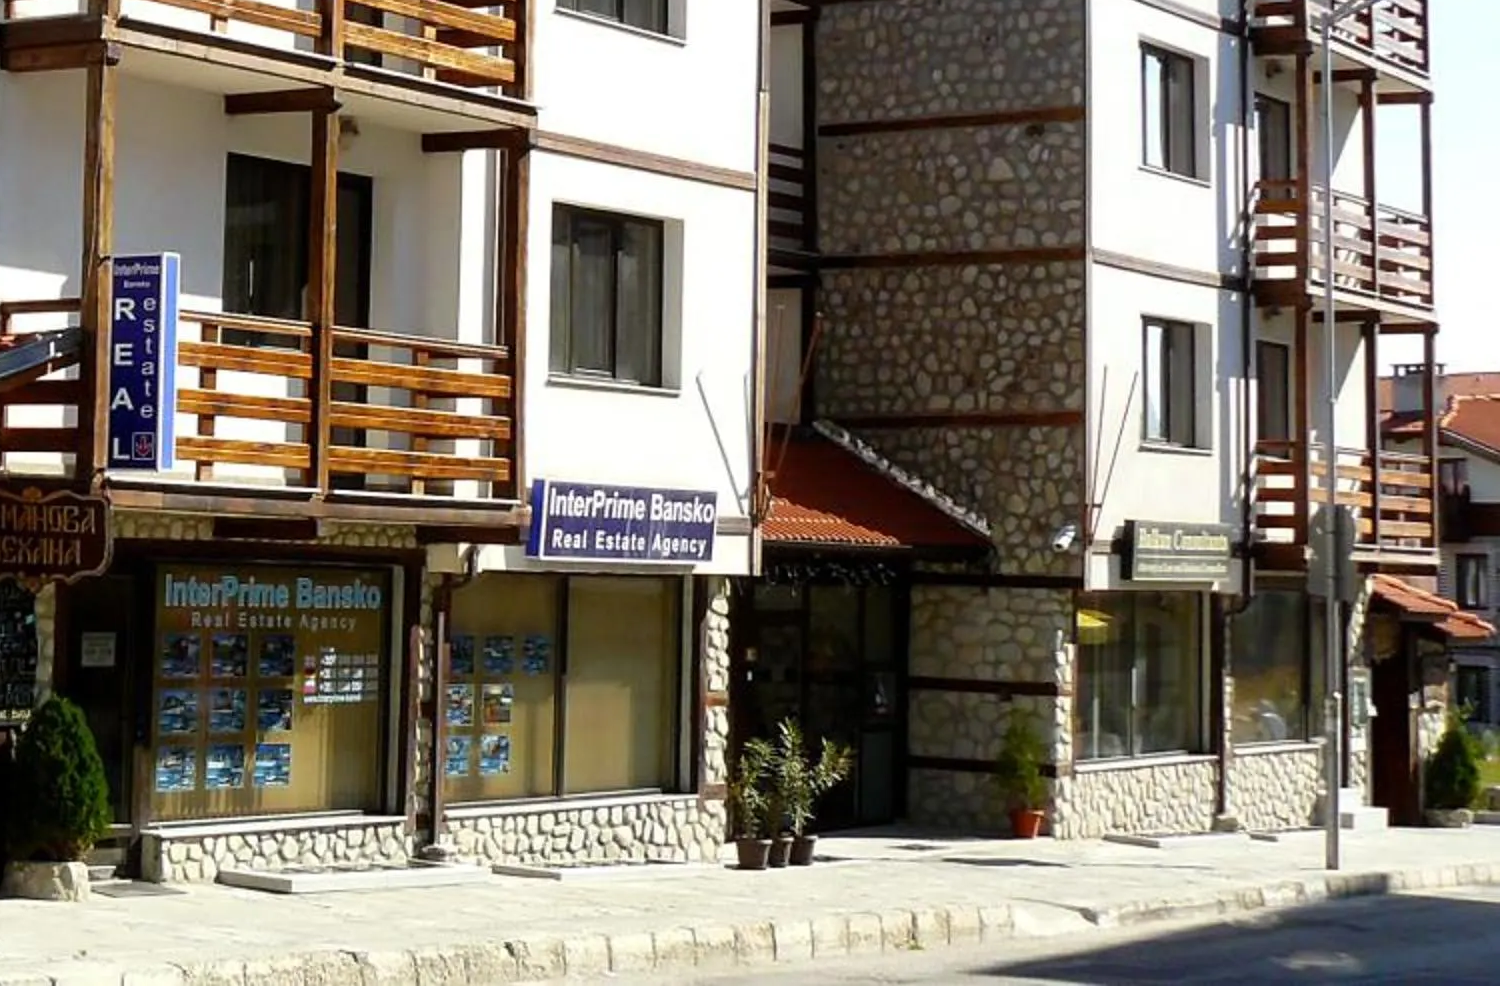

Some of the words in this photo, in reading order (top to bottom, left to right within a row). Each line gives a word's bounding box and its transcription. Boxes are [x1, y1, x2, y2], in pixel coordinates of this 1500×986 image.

[550, 487, 645, 520] InterPrime
[650, 493, 714, 523] Bansko
[552, 529, 587, 548] Real
[595, 530, 645, 551] Estate
[652, 533, 707, 557] Agency
[165, 574, 288, 608] InterPrime
[296, 577, 381, 609] Bansko
[191, 611, 229, 628] Real
[238, 612, 292, 628] Estate
[300, 614, 356, 631] Agency
